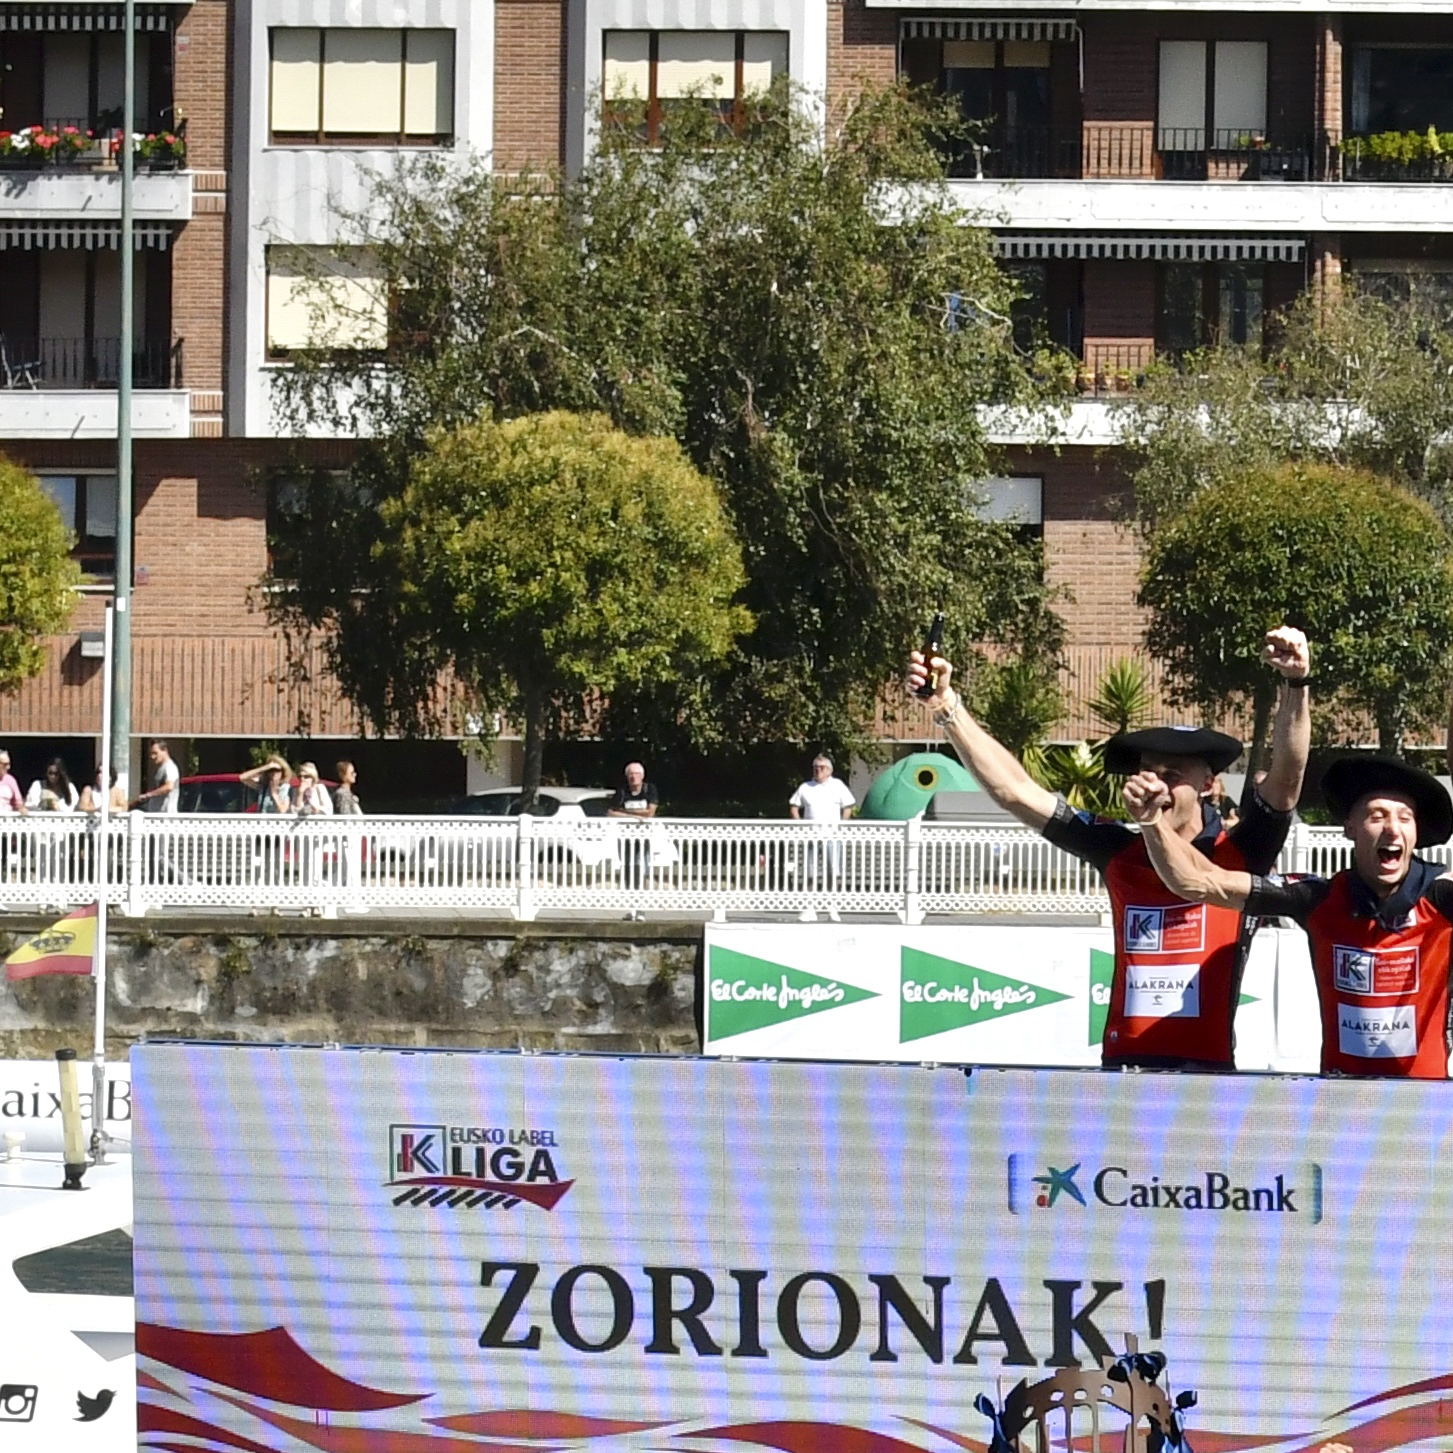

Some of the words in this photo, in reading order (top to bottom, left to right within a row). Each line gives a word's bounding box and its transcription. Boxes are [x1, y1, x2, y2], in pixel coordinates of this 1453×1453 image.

[711, 979, 732, 1002] El
[732, 980, 778, 1002] Corte
[779, 975, 844, 1010] Inglés
[903, 980, 922, 1003] El
[922, 981, 968, 1003] Corte
[969, 977, 1036, 1011] Inglés
[1128, 980, 1194, 990] ALAKRANA
[1341, 1020, 1411, 1032] ALAKRANA
[450, 1126, 506, 1146] EUSKO
[508, 1128, 559, 1149] LABEL
[451, 1146, 559, 1183] LIGA
[1093, 1165, 1299, 1213] CaixaBank
[480, 1262, 1166, 1367] ZORIONAK!
